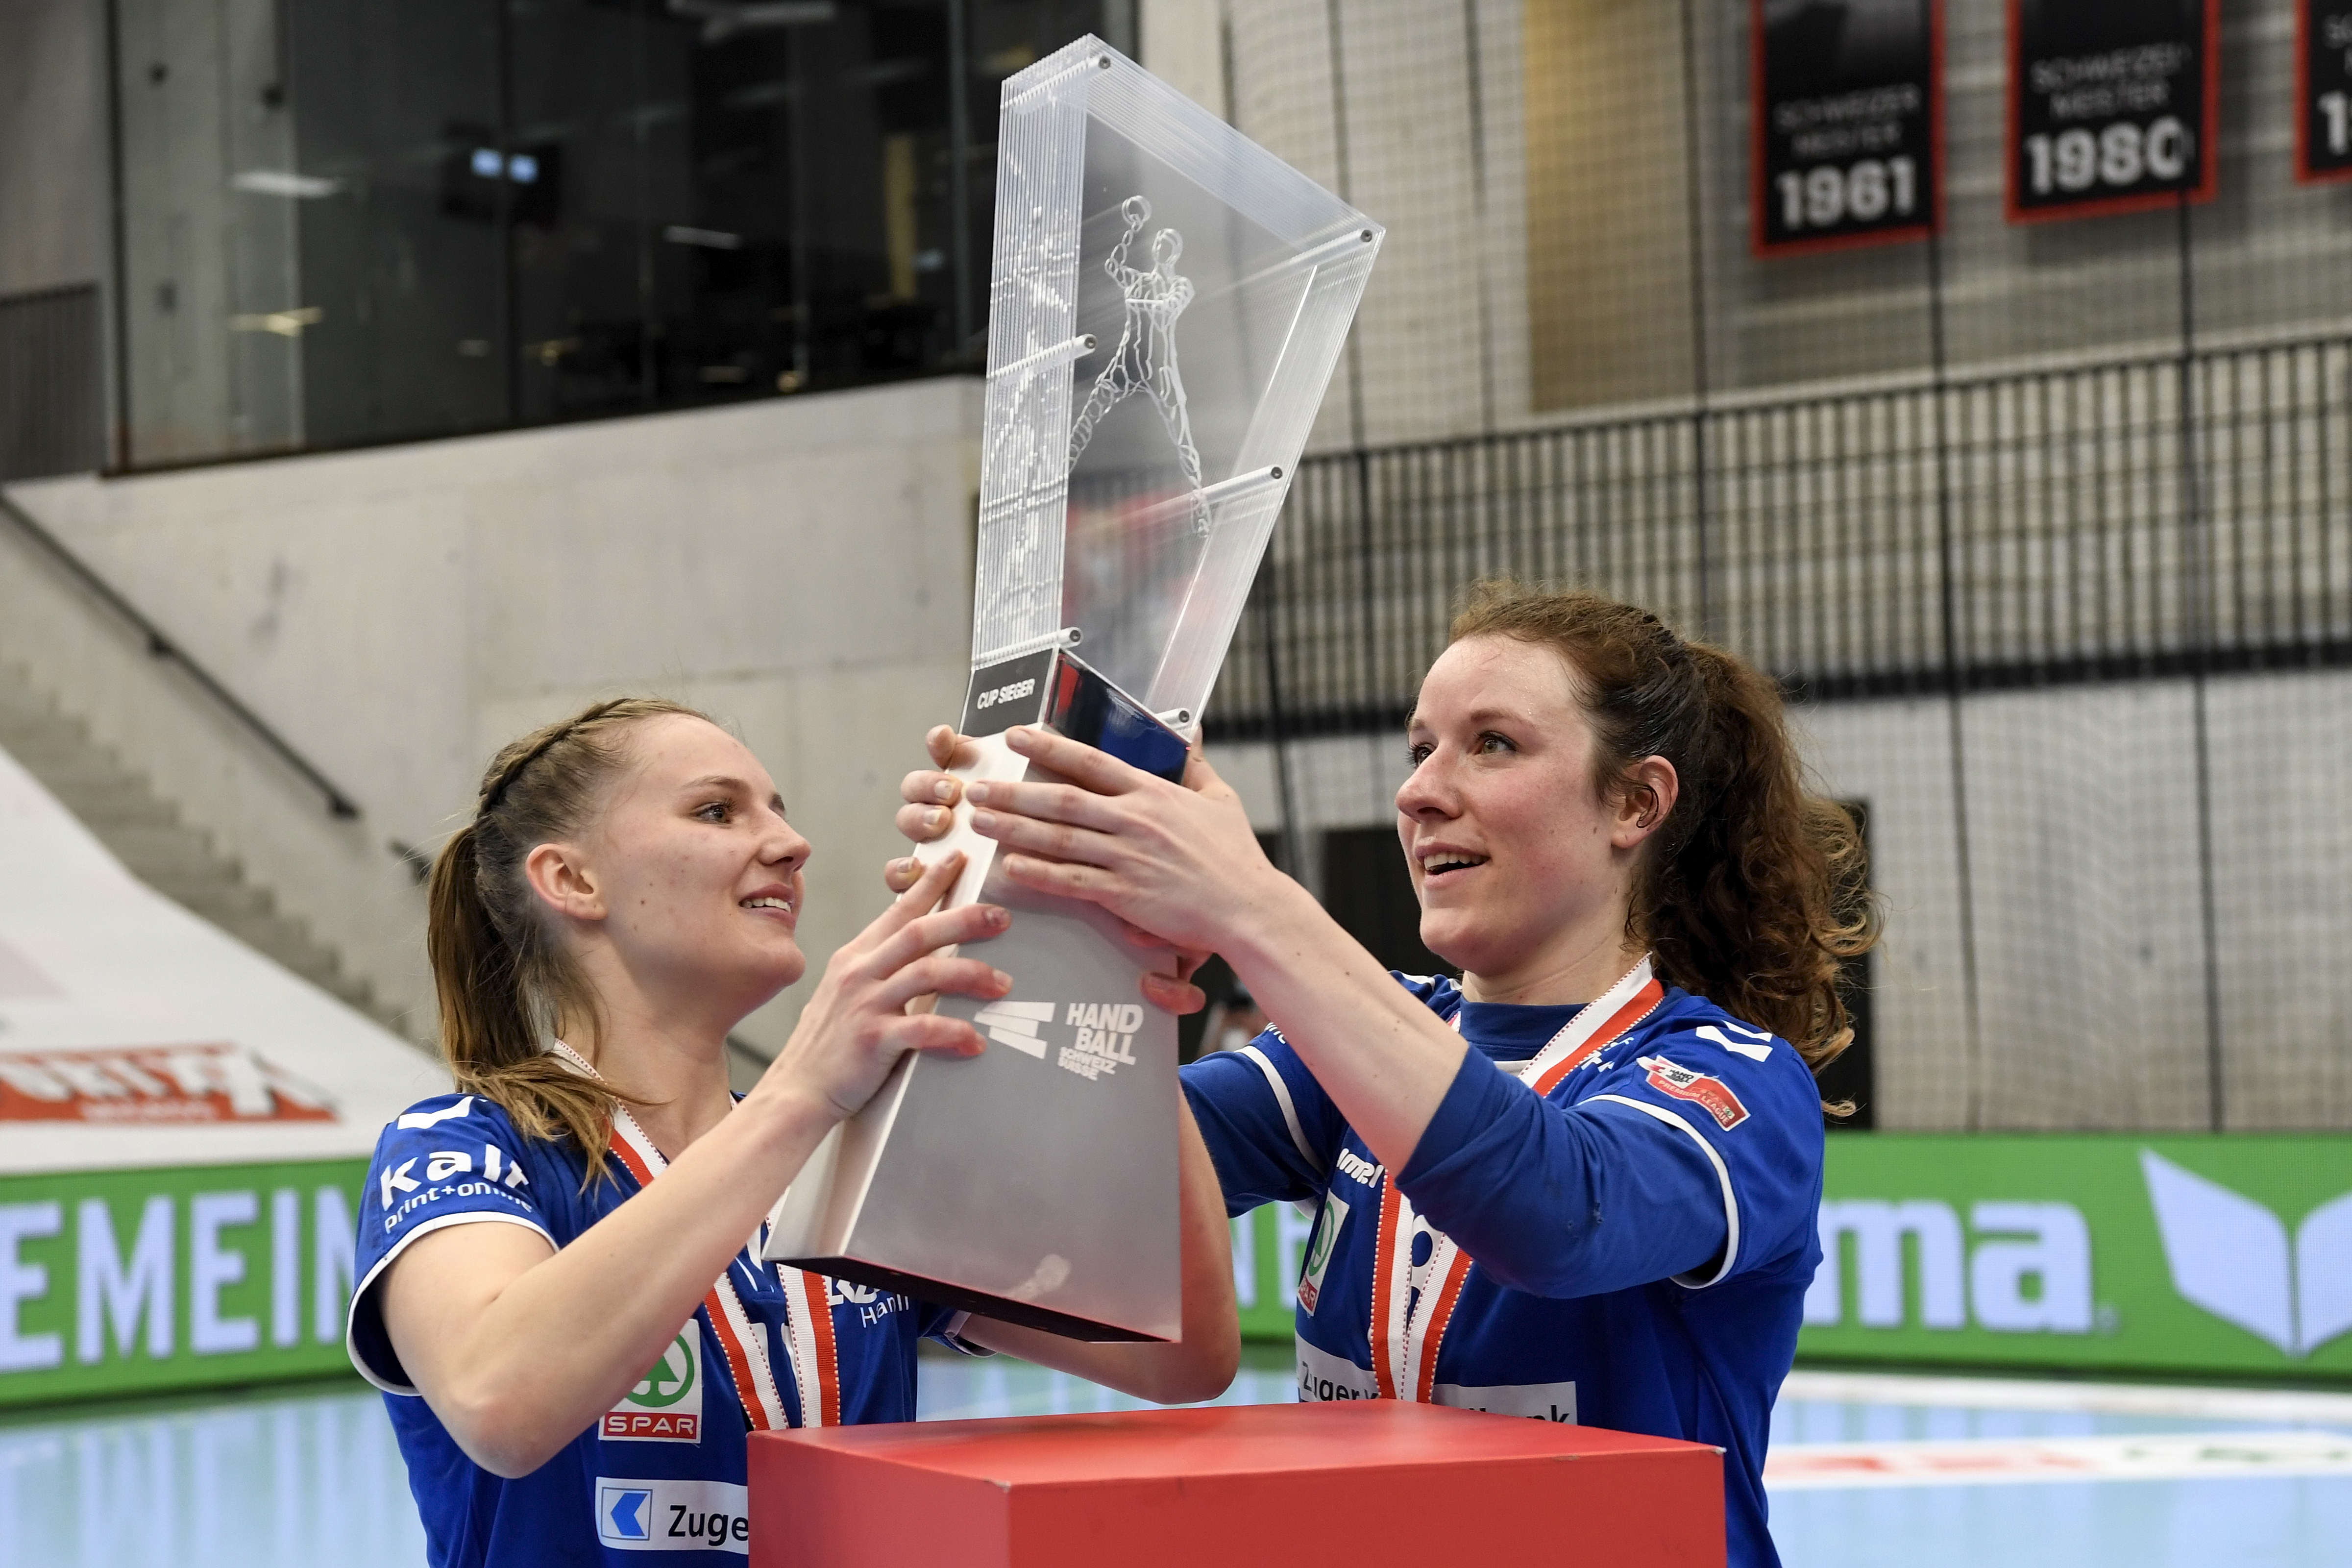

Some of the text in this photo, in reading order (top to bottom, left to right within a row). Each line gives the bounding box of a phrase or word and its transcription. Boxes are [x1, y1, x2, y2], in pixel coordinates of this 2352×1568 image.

[2024, 117, 2195, 194] 1980
[1776, 155, 1915, 230] 1961
[977, 678, 1035, 710] CUP SIEGER
[1065, 1003, 1144, 1034] HAND
[1075, 1028, 1136, 1066] BALL
[1658, 1079, 1730, 1125] PREMIUM LEAGUE
[608, 1416, 694, 1435] SPAR
